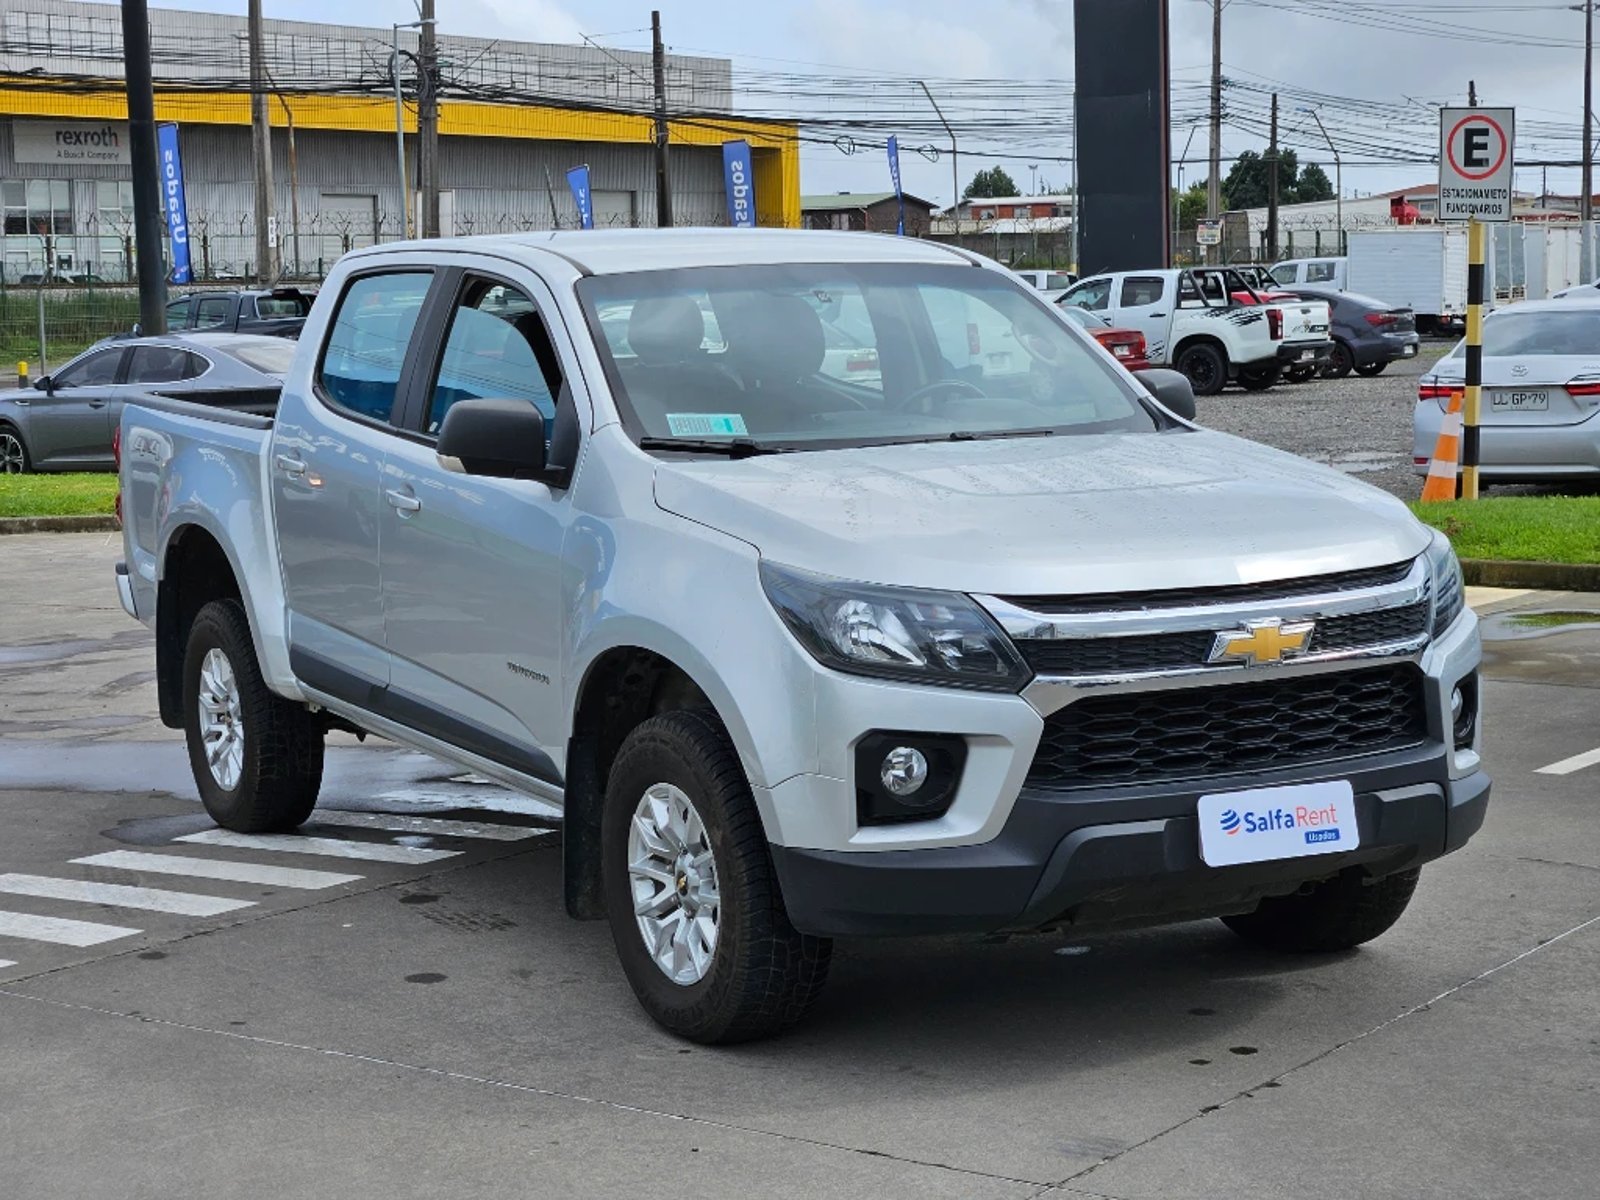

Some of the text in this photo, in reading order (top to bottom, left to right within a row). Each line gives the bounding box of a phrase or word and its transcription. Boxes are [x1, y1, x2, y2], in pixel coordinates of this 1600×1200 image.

[56, 126, 118, 147] rexroth
[57, 150, 62, 158] A
[87, 151, 119, 161] Company
[1464, 128, 1489, 168] E
[1446, 203, 1502, 214] FUNCIONARIOS
[134, 436, 160, 461] 44
[1243, 803, 1338, 833] SalfaRent
[1308, 831, 1337, 842] Usados
